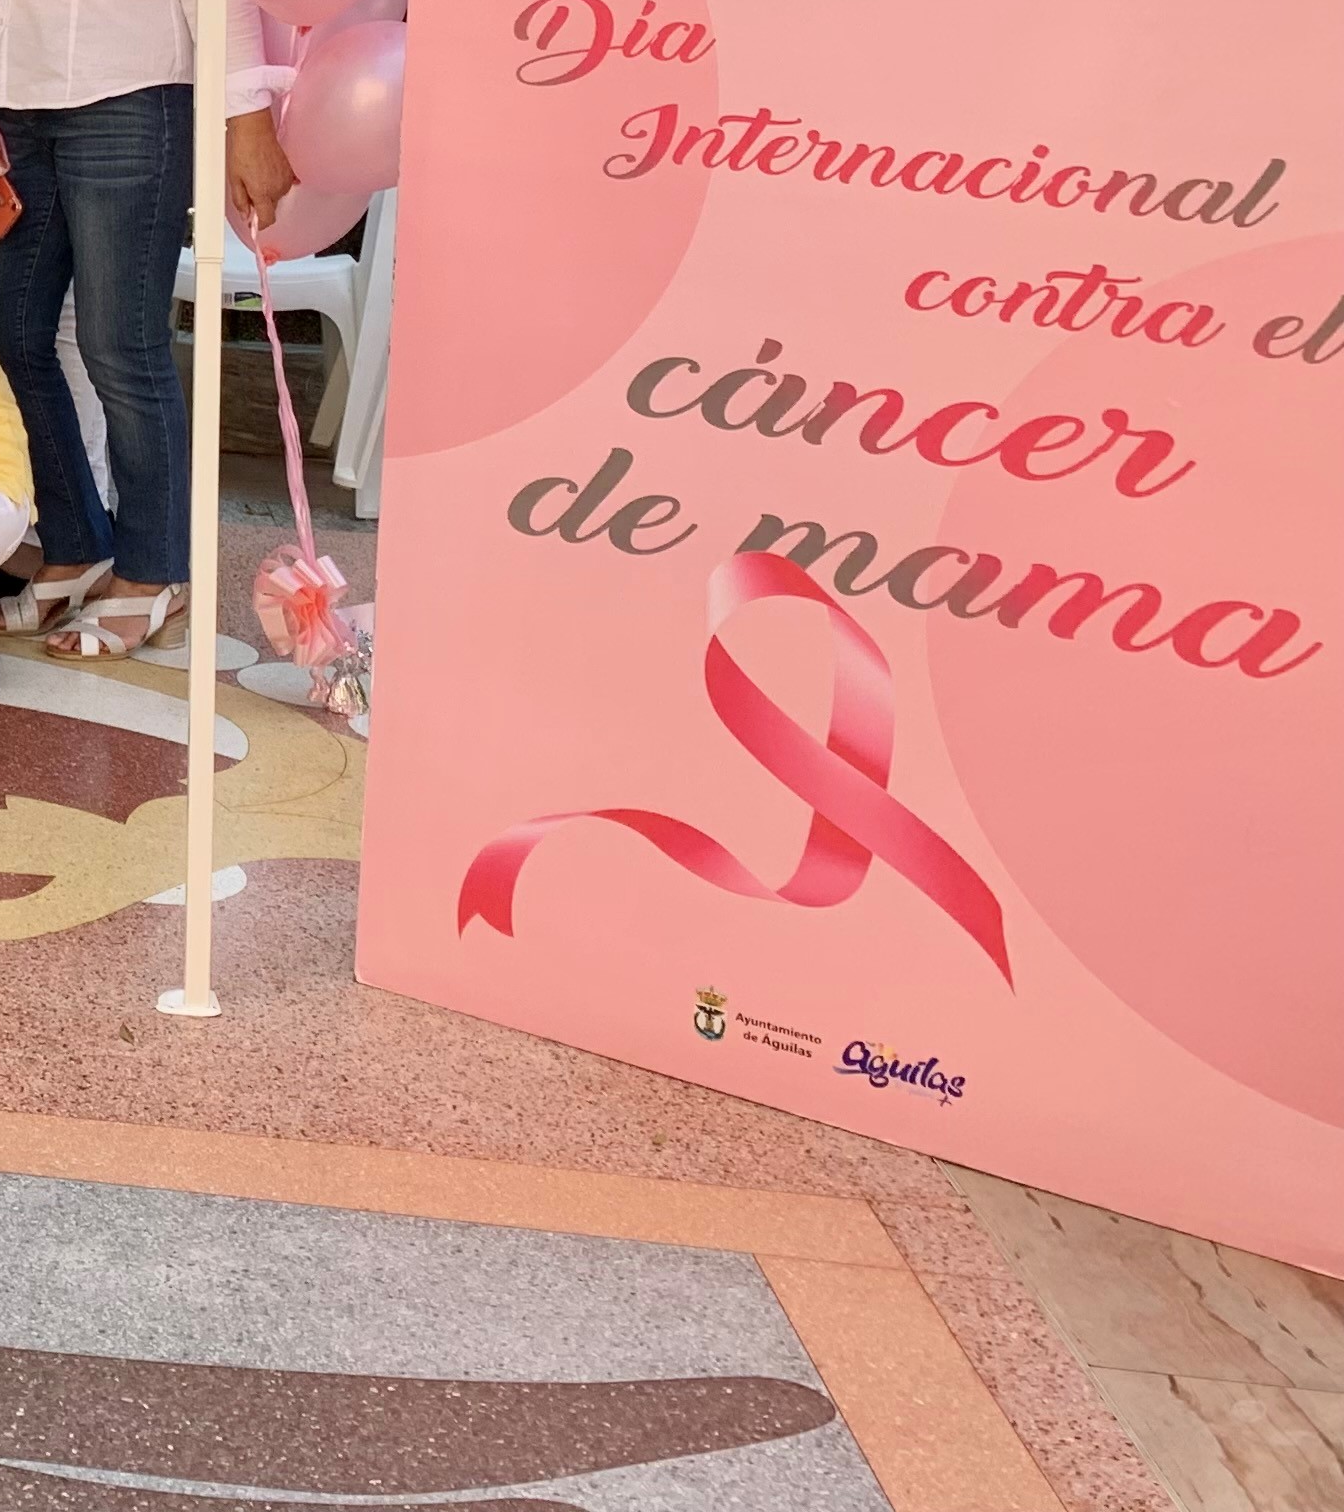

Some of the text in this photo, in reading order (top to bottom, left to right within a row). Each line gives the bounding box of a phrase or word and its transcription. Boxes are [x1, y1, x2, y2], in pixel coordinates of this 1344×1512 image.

[603, 104, 1287, 229] Internacional
[904, 264, 1344, 365] contra el
[626, 338, 1197, 499] cáncer
[507, 447, 1323, 679] de mama
[735, 1012, 822, 1044] Ayuntamiento
[743, 1031, 812, 1058] de Águilas
